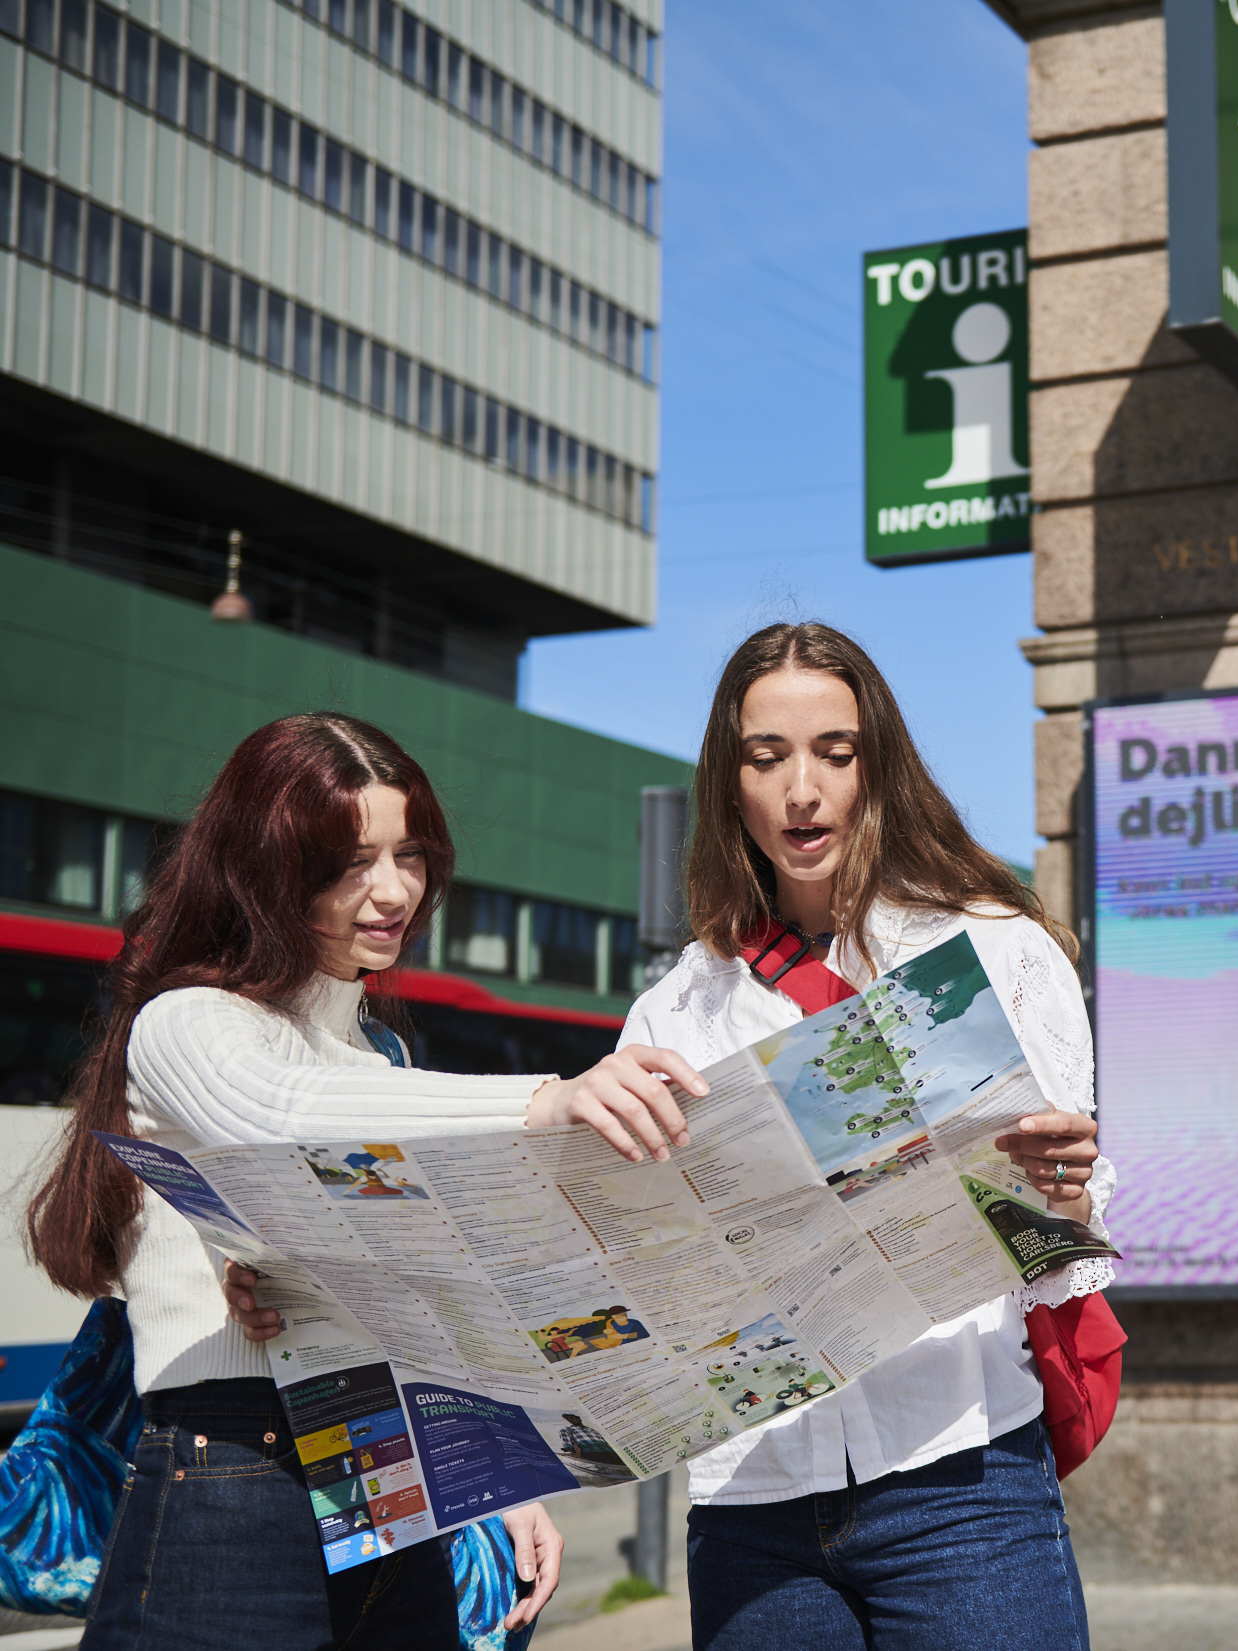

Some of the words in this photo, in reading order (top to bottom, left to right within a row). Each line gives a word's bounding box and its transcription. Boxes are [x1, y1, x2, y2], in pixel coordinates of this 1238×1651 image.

[867, 246, 1024, 304] TOURI
[108, 1142, 164, 1161] EXPLORE
[117, 1152, 198, 1176] COPENHAGEN
[125, 1161, 143, 1171] BY
[144, 1164, 188, 1180] PUBLIC
[136, 1169, 206, 1191] TRANSPORT
[731, 1229, 748, 1238] LOCAL
[1010, 1227, 1038, 1243] BOOK
[1013, 1232, 1040, 1248] YOUR
[1016, 1236, 1046, 1252] TICKET
[1019, 1241, 1048, 1257] HOME
[1023, 1240, 1074, 1262] CARLSBERG
[283, 1380, 335, 1400] Sustainable
[286, 1386, 341, 1408] Copenhagen
[415, 1393, 455, 1406] GUIDE
[456, 1396, 474, 1407] TO
[474, 1401, 517, 1419] PUBLIC
[419, 1404, 496, 1420] TRANSPORT
[452, 1439, 470, 1448] JOURNEY
[434, 1463, 448, 1471] SINGLE
[449, 1458, 465, 1466] TICKETS
